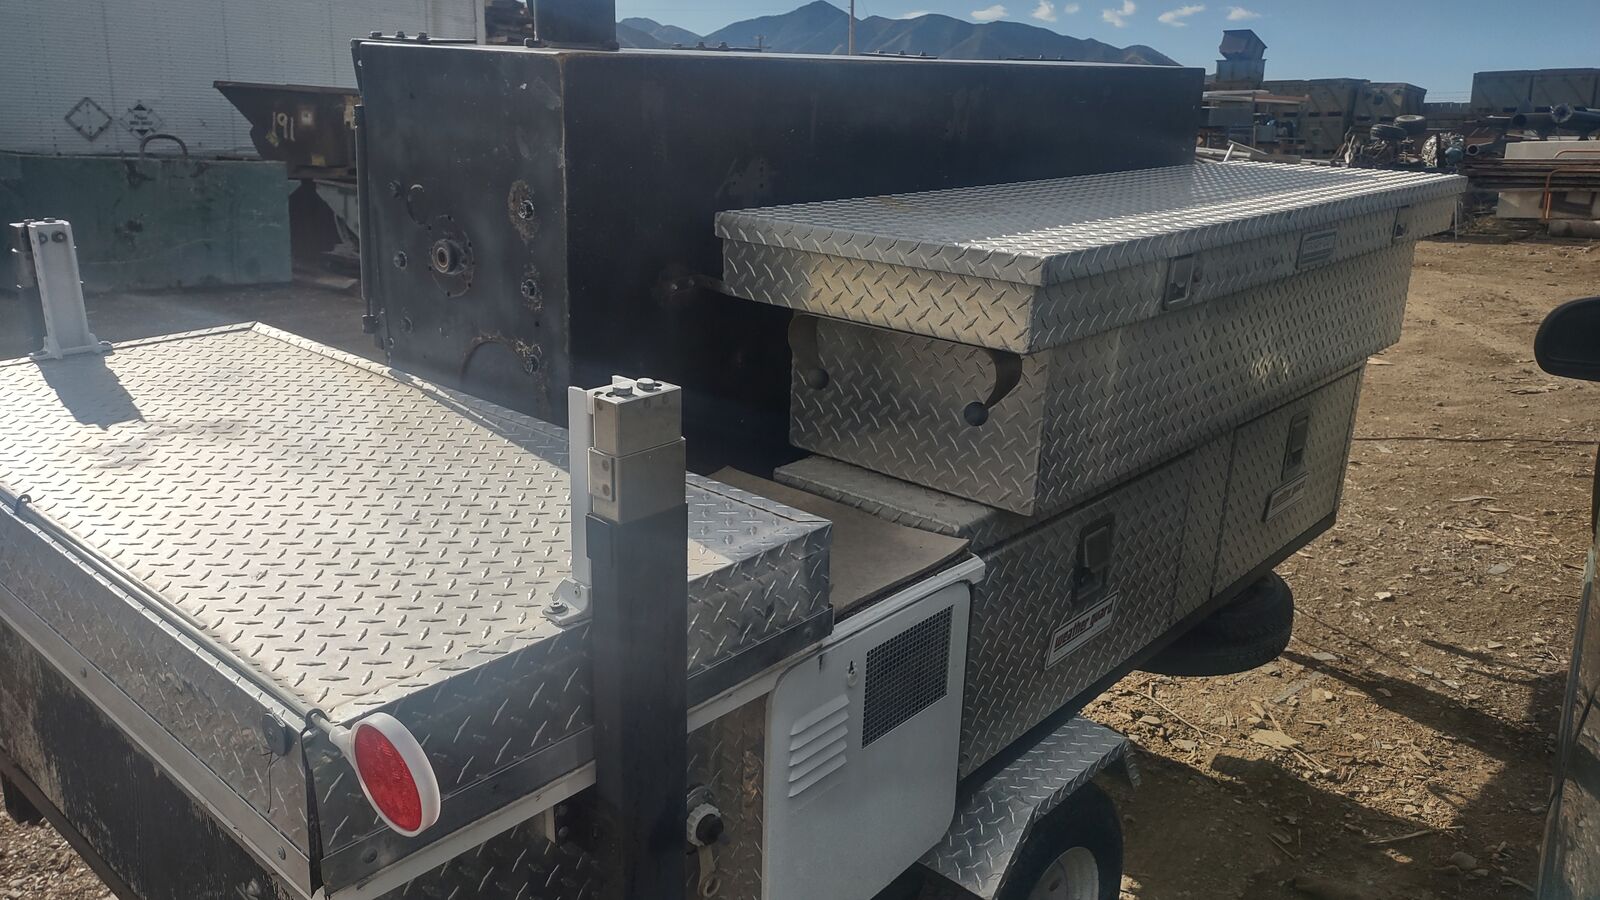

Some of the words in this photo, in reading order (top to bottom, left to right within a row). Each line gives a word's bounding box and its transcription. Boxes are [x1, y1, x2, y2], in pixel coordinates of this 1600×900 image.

[272, 112, 296, 141] 191
[1054, 617, 1090, 647] weather
[1089, 599, 1114, 625] guard
